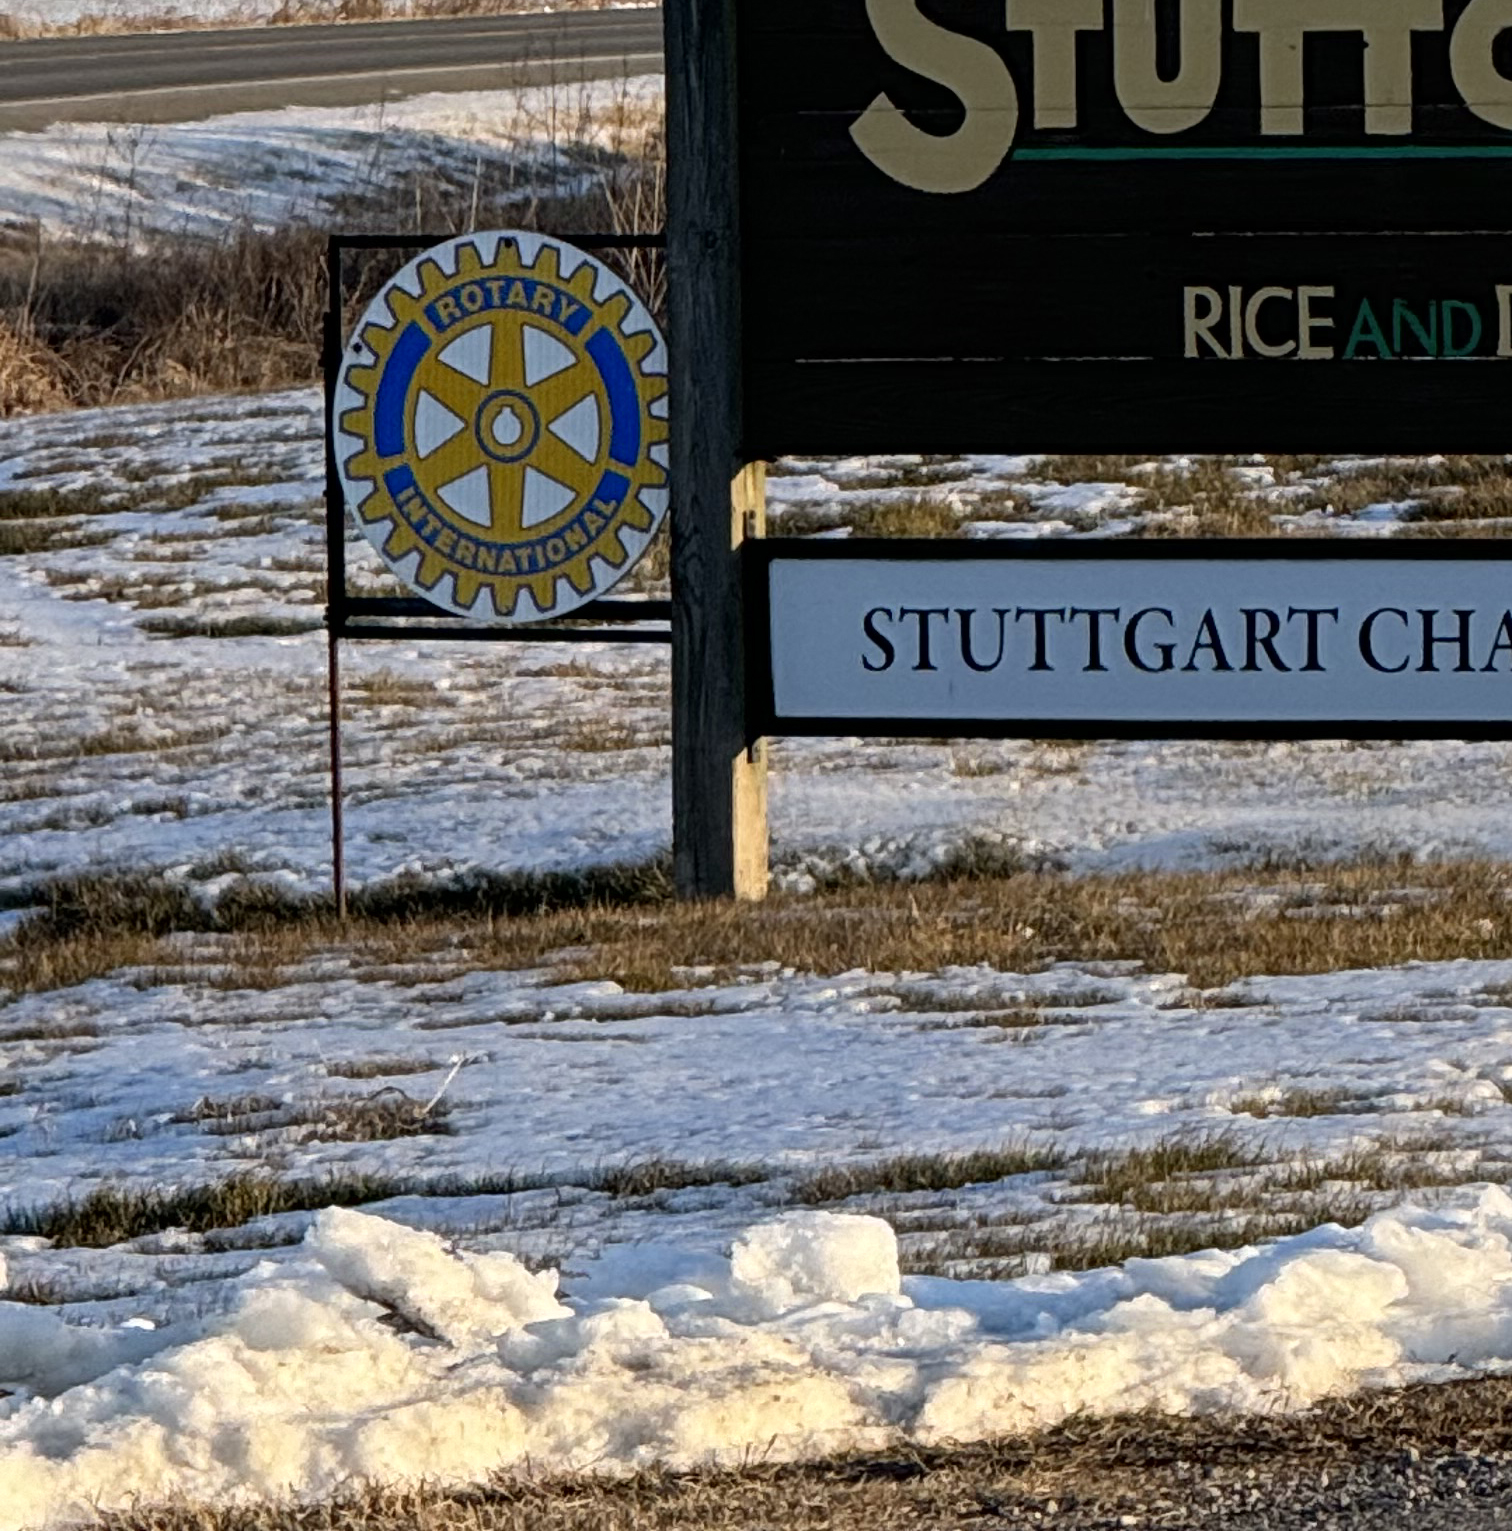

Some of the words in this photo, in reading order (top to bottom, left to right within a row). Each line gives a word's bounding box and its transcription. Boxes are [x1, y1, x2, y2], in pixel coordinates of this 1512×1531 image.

[436, 279, 581, 326] ROTARY
[1184, 284, 1335, 359] RICE
[1343, 297, 1482, 357] AND
[398, 486, 618, 573] INTERNATIONAL
[862, 606, 1339, 674] STUTTGART
